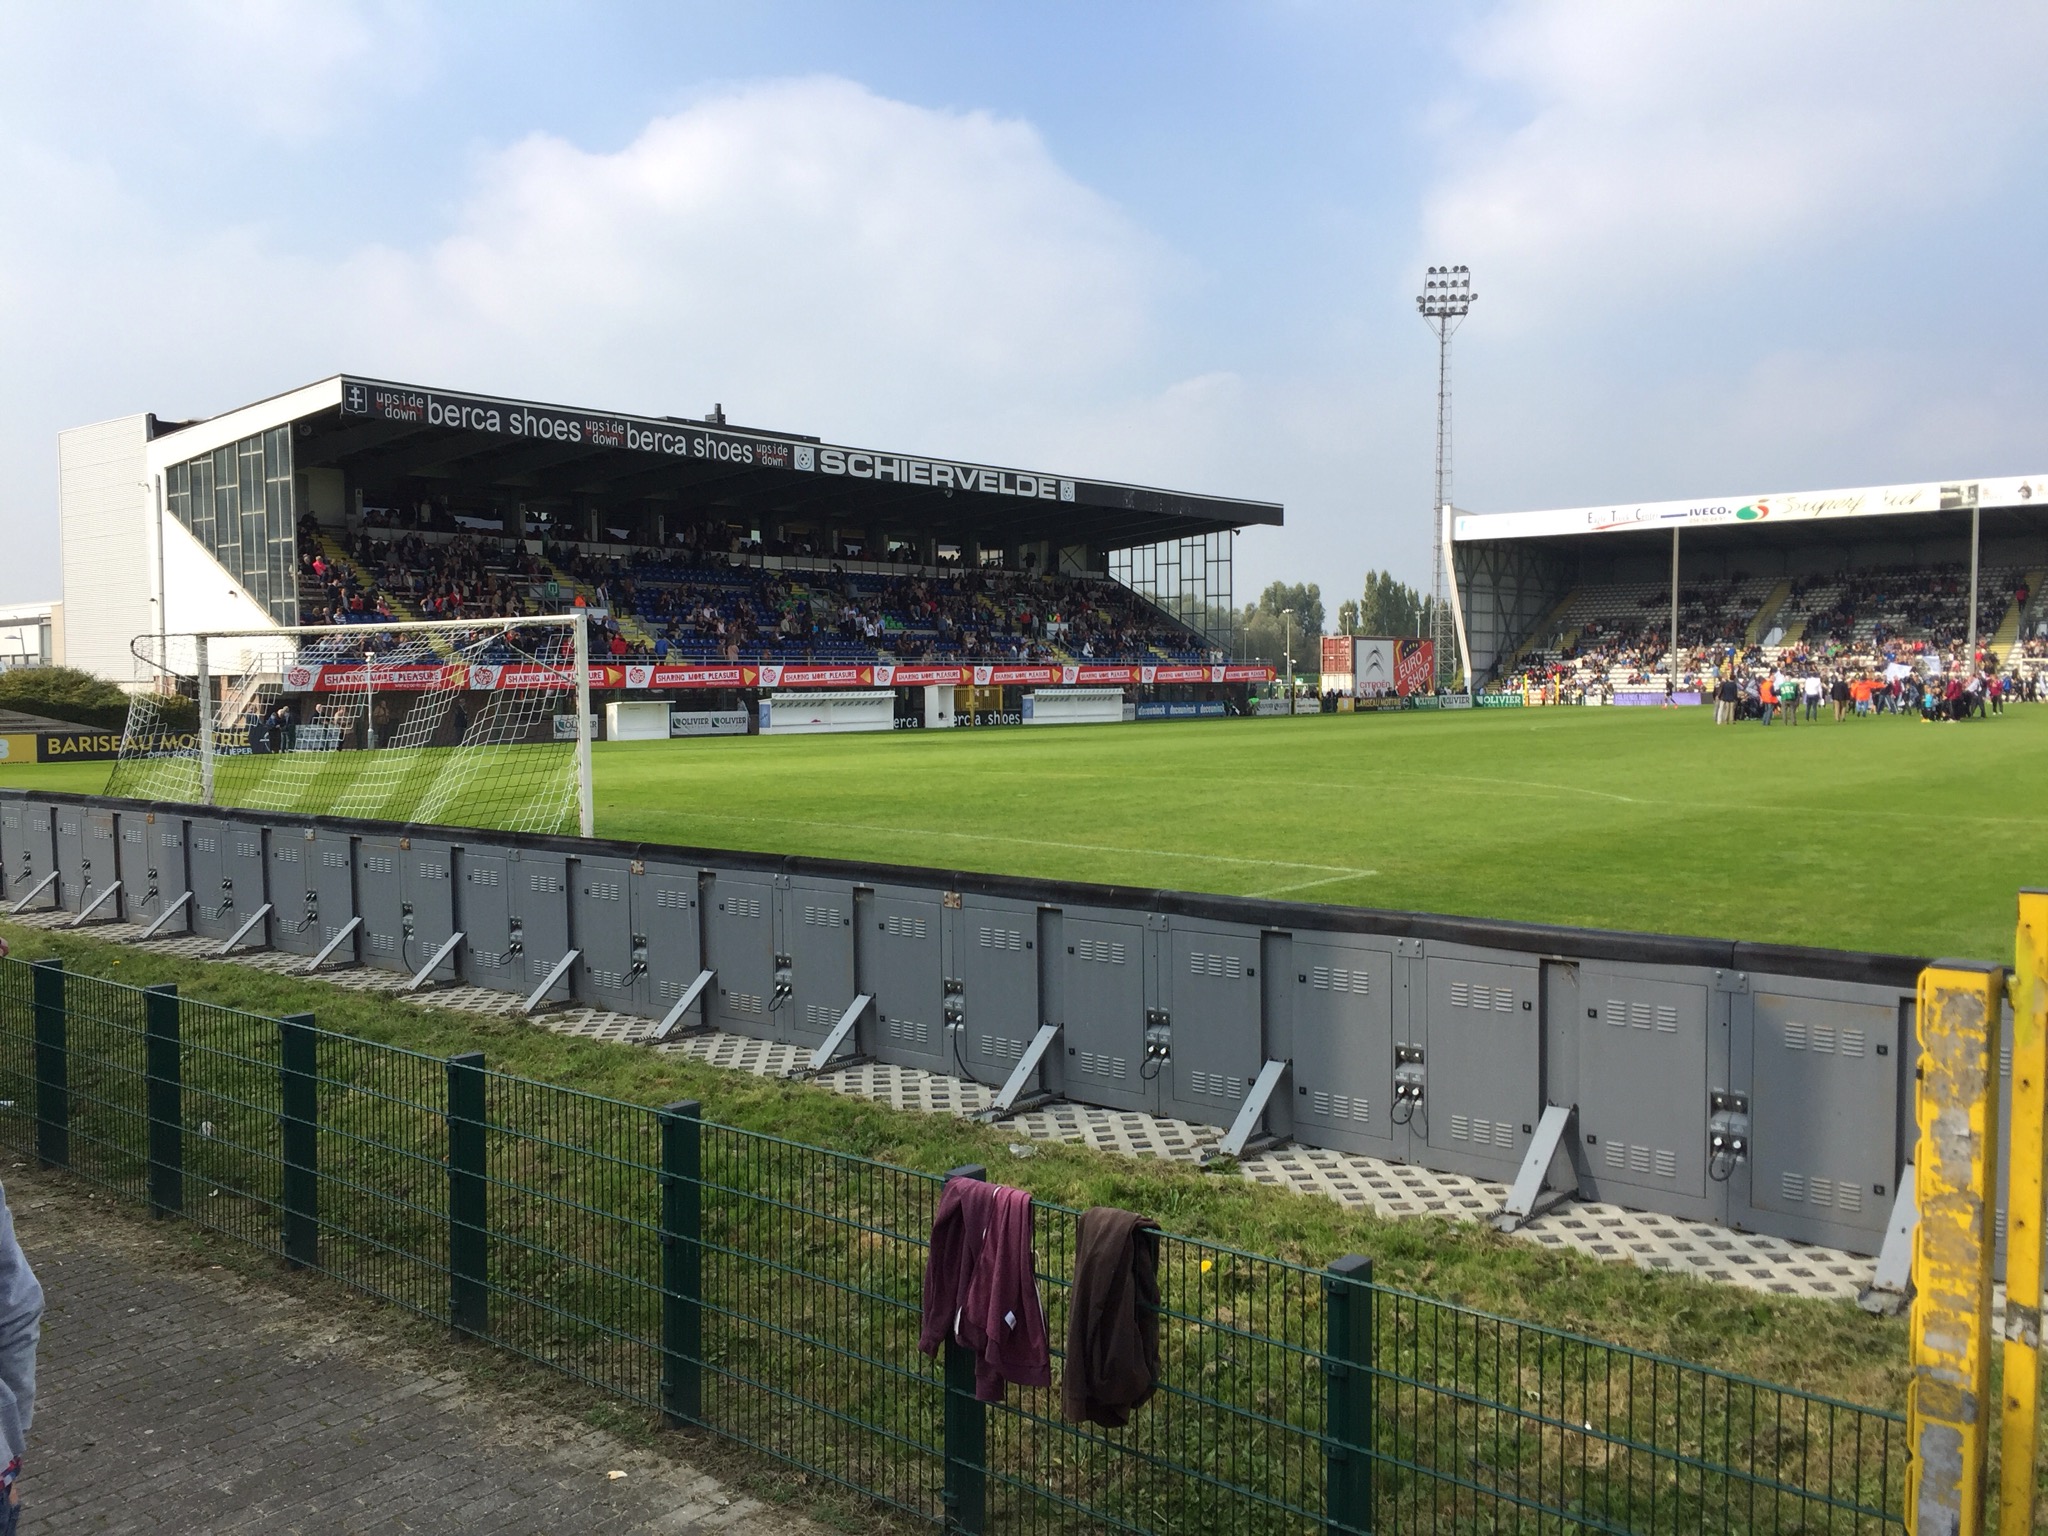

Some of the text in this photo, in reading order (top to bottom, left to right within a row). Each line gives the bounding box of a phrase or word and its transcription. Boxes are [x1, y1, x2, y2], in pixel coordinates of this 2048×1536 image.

[376, 391, 424, 408] upside
[384, 404, 416, 421] down
[427, 395, 582, 442] berca shoes
[585, 419, 624, 435] upside
[592, 431, 618, 446] down
[626, 422, 753, 464] berca shoes
[756, 443, 788, 456] upside
[762, 454, 783, 467] down
[820, 450, 1057, 500] SCHIERVELDE
[1689, 506, 1727, 516] IVECO
[1399, 651, 1422, 679] EURO
[657, 671, 738, 682] SHARING MORE PLEASURE
[785, 673, 810, 682] SHARING
[812, 672, 827, 680] MORE
[829, 671, 855, 679] PLEASURE
[936, 671, 959, 679] PLEASURE
[1407, 662, 1430, 690] SHOP
[1484, 695, 1521, 704] OLIVIER
[681, 717, 709, 726] OLIVIER
[720, 716, 746, 725] OLIVIER
[987, 711, 1020, 726] shoes
[47, 734, 153, 755] BARISEAU
